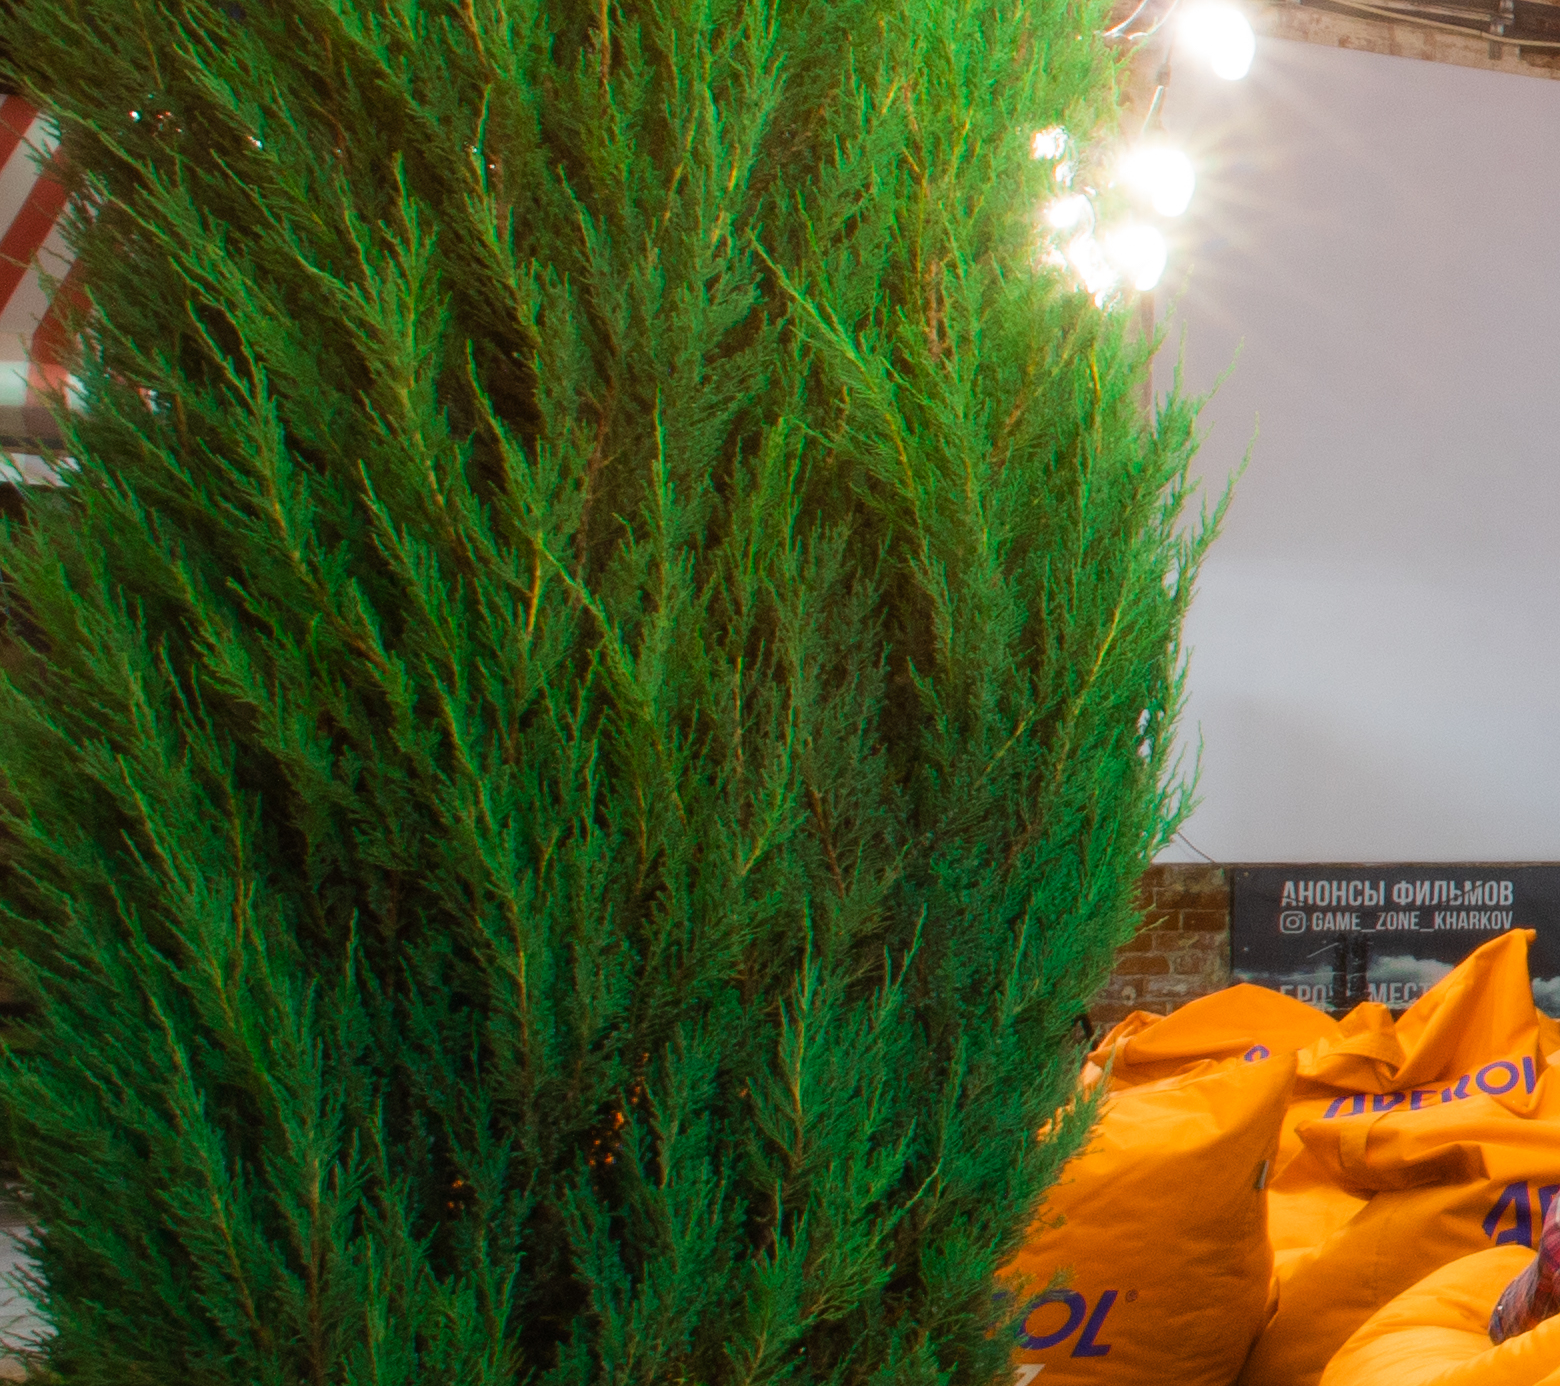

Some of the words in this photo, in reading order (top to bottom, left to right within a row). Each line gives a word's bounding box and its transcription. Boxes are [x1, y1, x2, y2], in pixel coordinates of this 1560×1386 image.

[1281, 880, 1386, 907] АНОНСЫ
[1392, 879, 1514, 906] ФИЛЬМОВ
[1312, 910, 1514, 933] GAME_ZONE_KHARKOV
